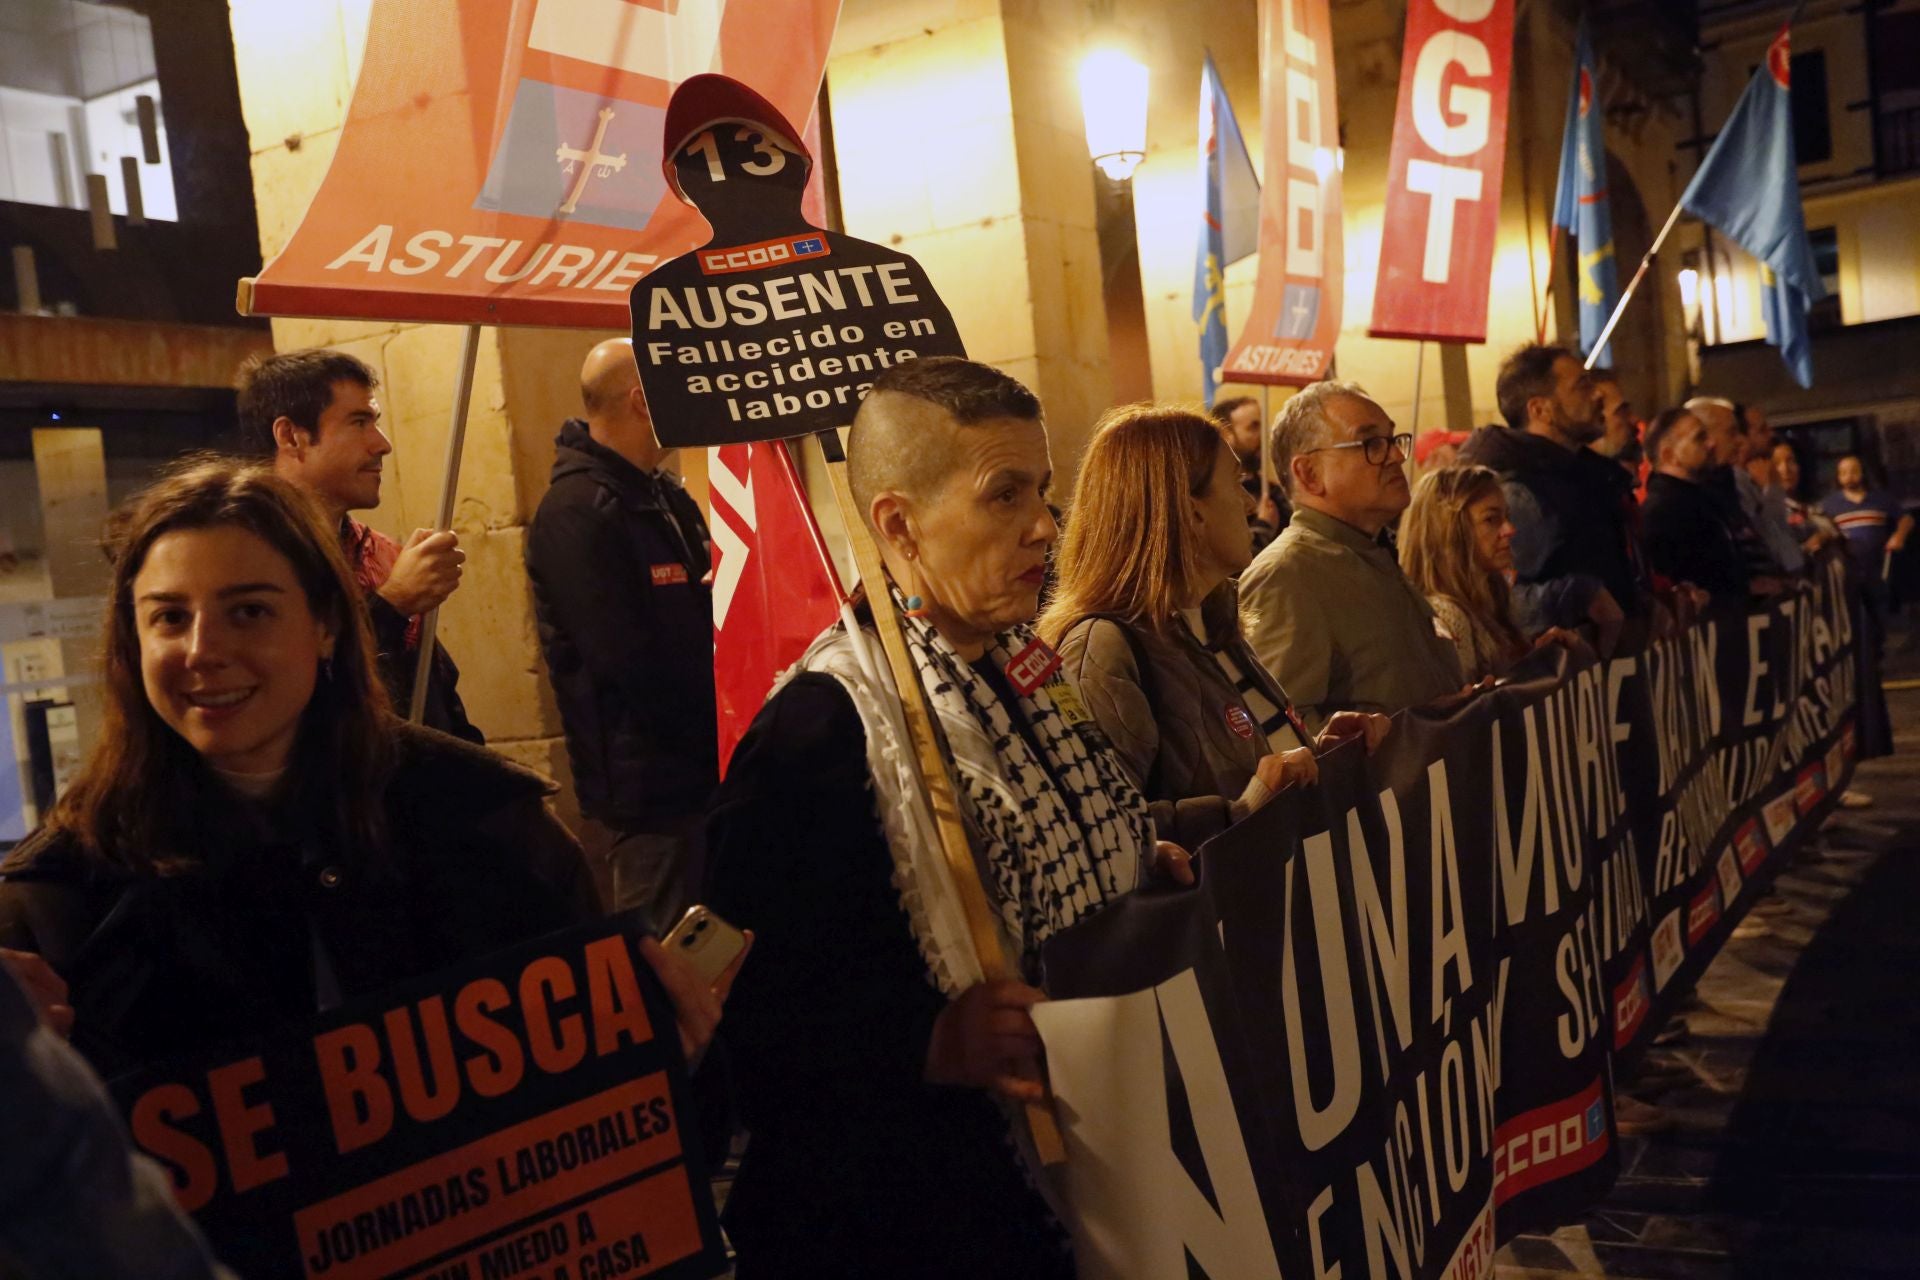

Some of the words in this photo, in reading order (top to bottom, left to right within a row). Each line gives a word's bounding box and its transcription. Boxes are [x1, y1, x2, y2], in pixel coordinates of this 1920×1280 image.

[686, 127, 787, 182] 13
[1406, 0, 1496, 284] GT
[325, 224, 664, 292] ASTURIE
[705, 244, 790, 271] CCOO
[648, 262, 920, 330] AUSENTE
[648, 324, 865, 367] Fallecido
[883, 317, 937, 339] en
[686, 347, 918, 394] accidente
[1233, 345, 1323, 374] ASTURIES
[728, 382, 875, 421] labora
[1282, 758, 1473, 1152] UNA
[130, 1055, 290, 1213] SE
[313, 933, 655, 1155] BUSCA
[1306, 999, 1496, 1280] ENCIÓN
[309, 1166, 489, 1272] JORNADAS
[496, 1095, 672, 1196] LABORALES
[480, 1222, 568, 1280] MIEDO
[576, 1211, 597, 1246] A
[579, 1234, 650, 1280] CASA
